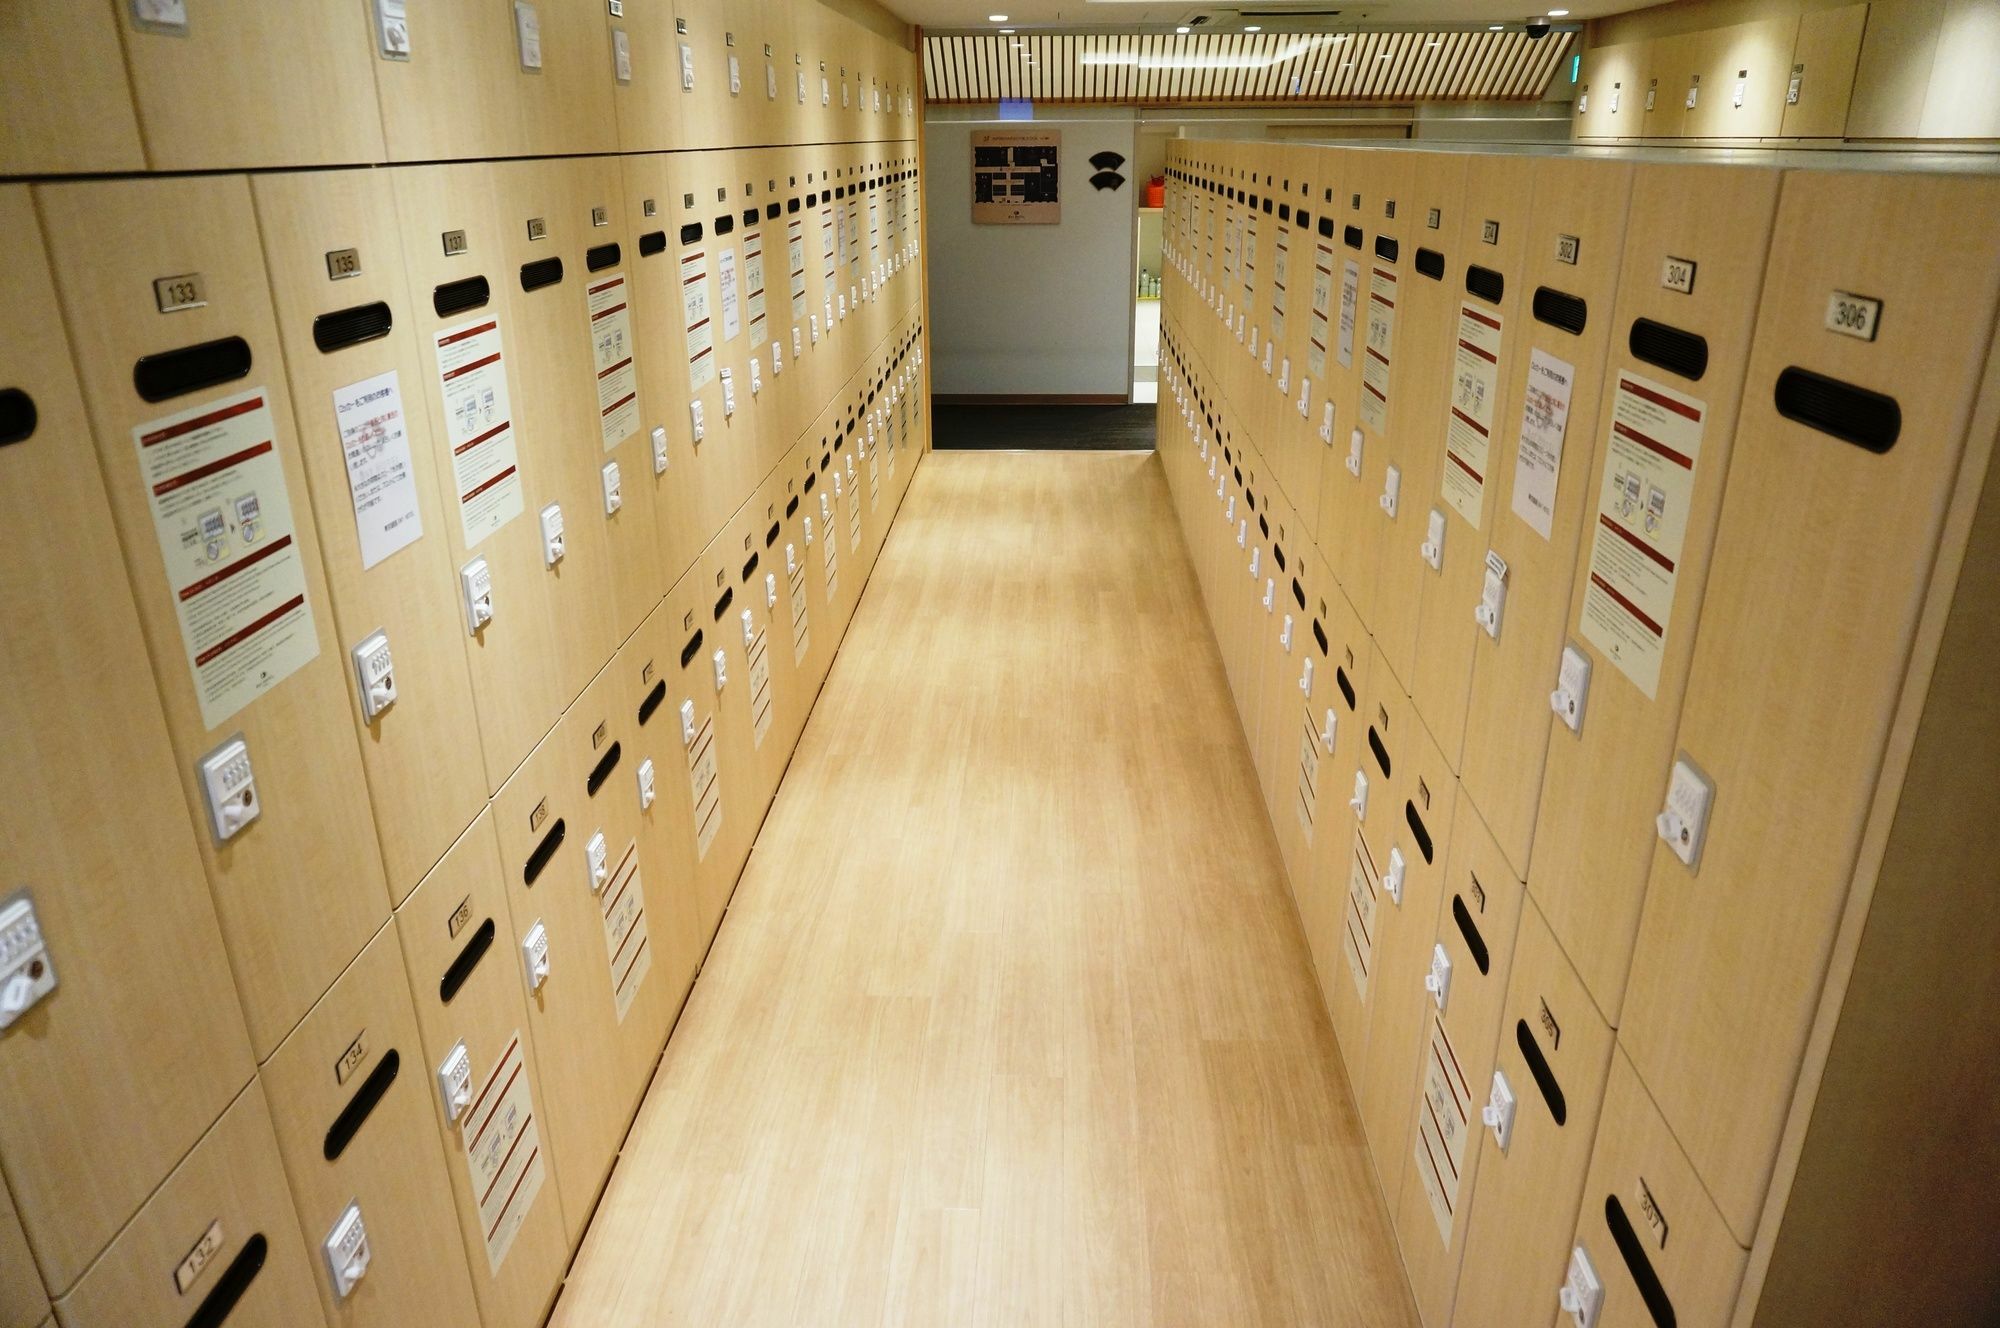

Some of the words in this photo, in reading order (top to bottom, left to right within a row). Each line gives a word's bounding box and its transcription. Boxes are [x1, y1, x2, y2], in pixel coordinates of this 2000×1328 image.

[449, 236, 462, 250] 137
[1559, 241, 1573, 259] 302
[336, 255, 354, 272] 135
[1667, 265, 1686, 285] 304
[168, 282, 195, 303] 133
[1836, 302, 1867, 331] 306
[455, 905, 469, 927] 136
[344, 1043, 363, 1070] 134
[1641, 1194, 1659, 1229] 307
[188, 1237, 213, 1273] 132
